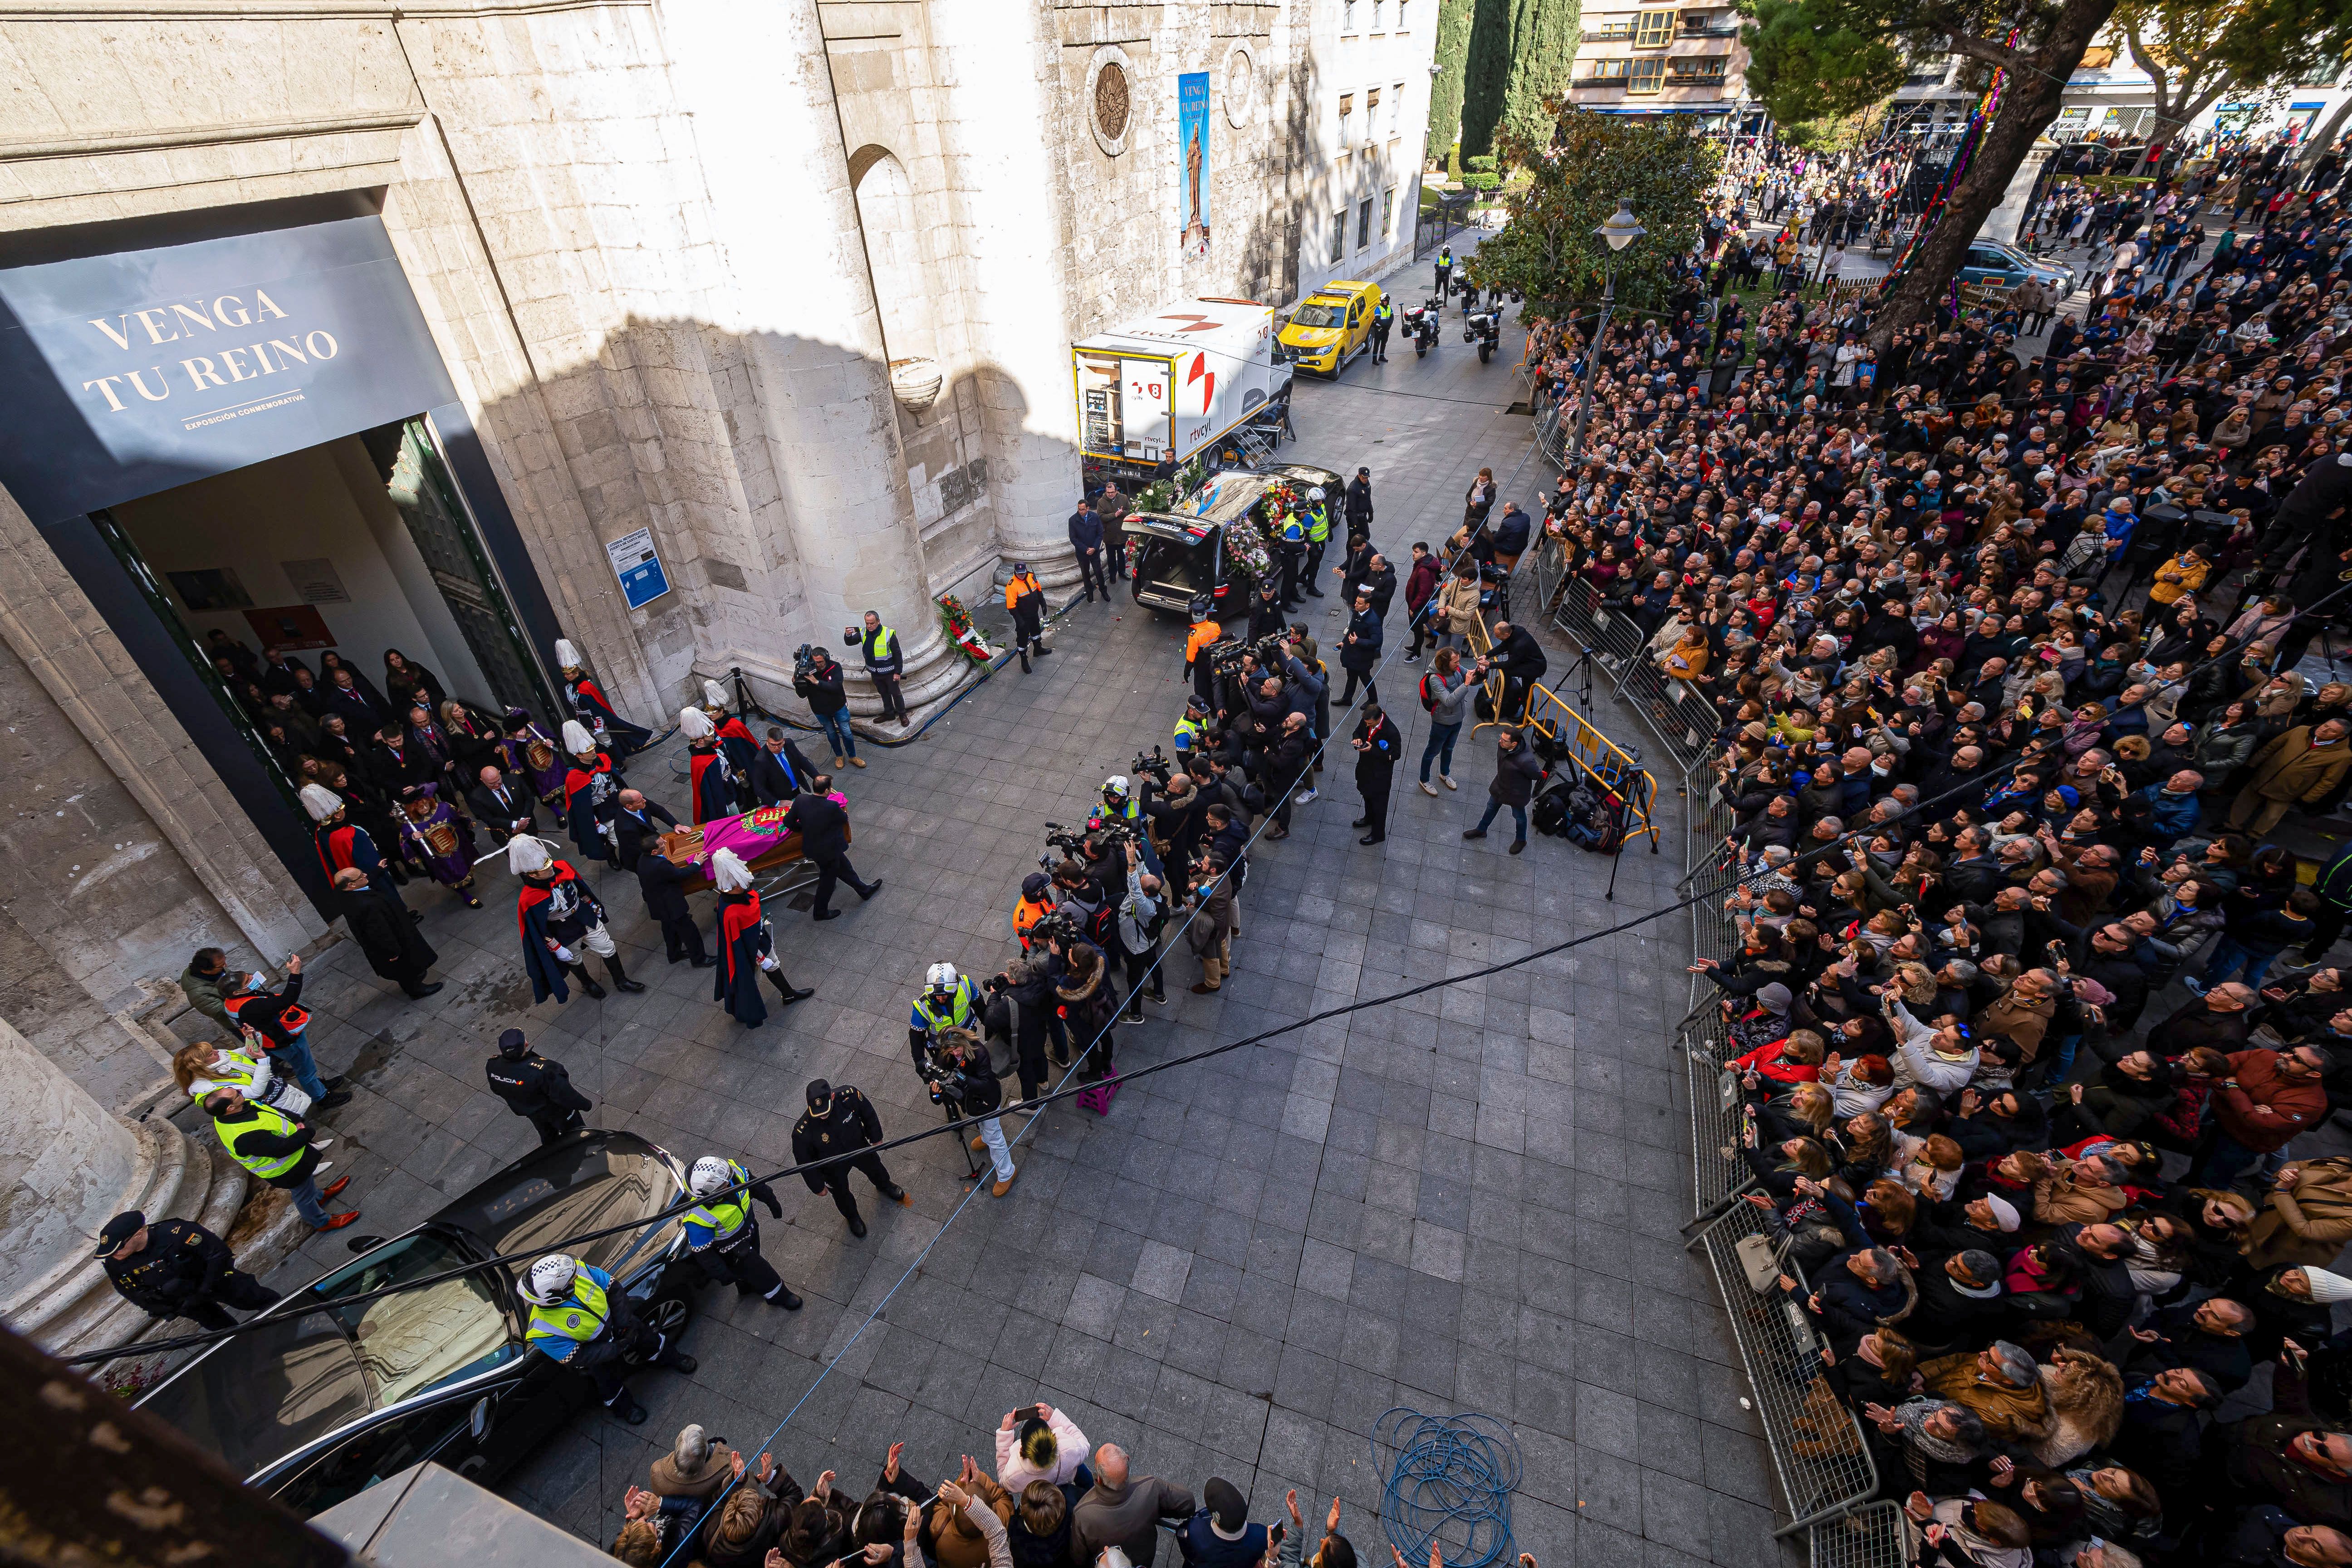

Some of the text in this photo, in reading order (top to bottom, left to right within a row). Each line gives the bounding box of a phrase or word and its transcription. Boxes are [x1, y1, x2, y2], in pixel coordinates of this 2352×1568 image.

[1185, 85, 1205, 97] VENGA
[88, 289, 289, 350] VENGA
[83, 330, 338, 412] TU REINO
[1152, 385, 1159, 397] 8
[185, 393, 306, 431] EXPOSICIÓN CONMEMORATIVA
[1190, 417, 1211, 444] rtvcyl
[491, 1073, 516, 1083] POLICIA
